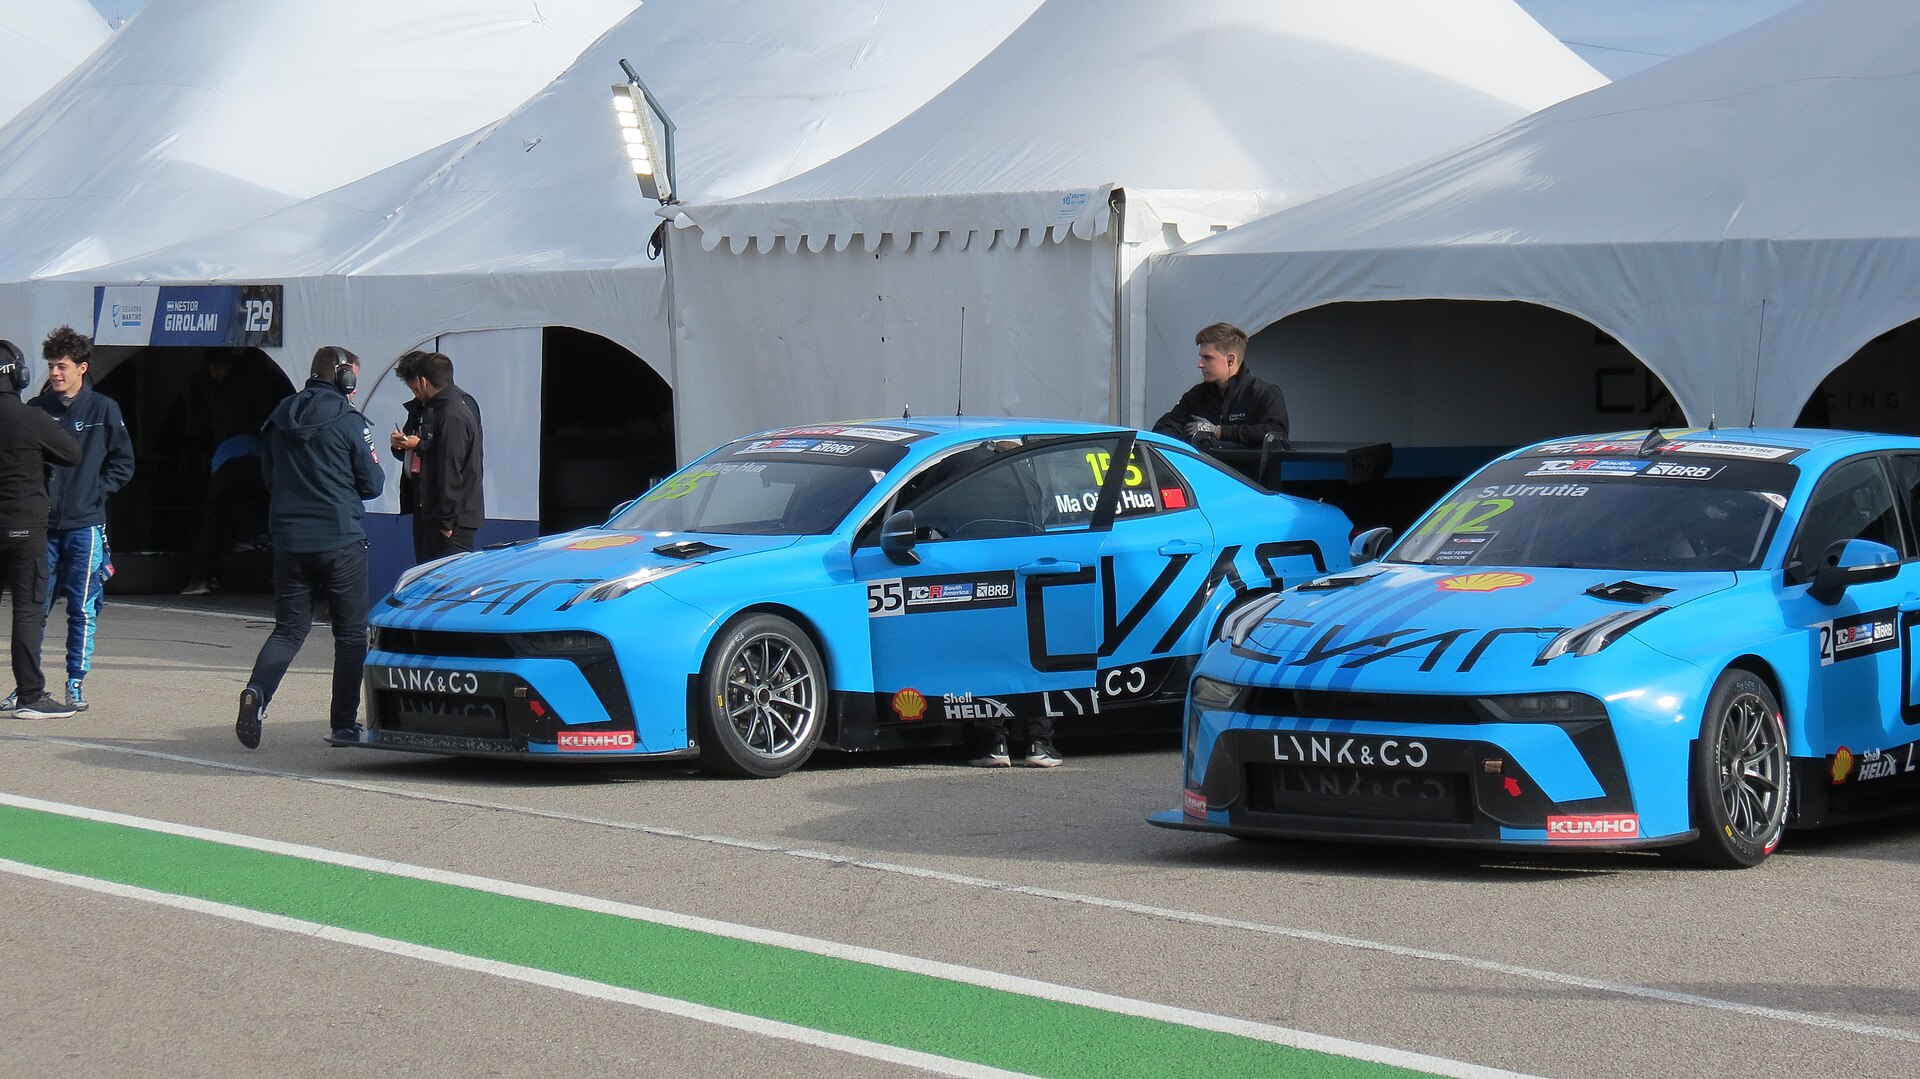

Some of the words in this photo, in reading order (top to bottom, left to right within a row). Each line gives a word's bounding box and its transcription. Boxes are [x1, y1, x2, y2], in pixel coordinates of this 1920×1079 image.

[174, 301, 198, 311] NESTOR
[164, 313, 218, 332] GIROLAMI
[244, 300, 273, 331] 129
[823, 443, 856, 454] BRB
[1699, 443, 1747, 451] KUMHO
[1537, 460, 1597, 471] TCR
[1666, 465, 1712, 477] BRB
[1055, 494, 1081, 513] Ma
[1082, 492, 1122, 515] Qig
[1121, 490, 1155, 509] Hua
[1419, 498, 1515, 536] 112
[909, 585, 943, 599] TCR
[942, 589, 970, 597] America
[988, 584, 1009, 597] BRB
[1836, 626, 1856, 645] TCR
[1880, 623, 1893, 638] BRB
[388, 667, 478, 694] LYNK&CO
[943, 691, 973, 704] Shell
[944, 700, 1015, 719] HELIX
[560, 734, 633, 748] KUMHO
[1273, 735, 1428, 768] LYNK&CO
[1863, 747, 1881, 762] Shell
[1857, 757, 1897, 782] HELIX
[1550, 818, 1636, 835] KUMHO
